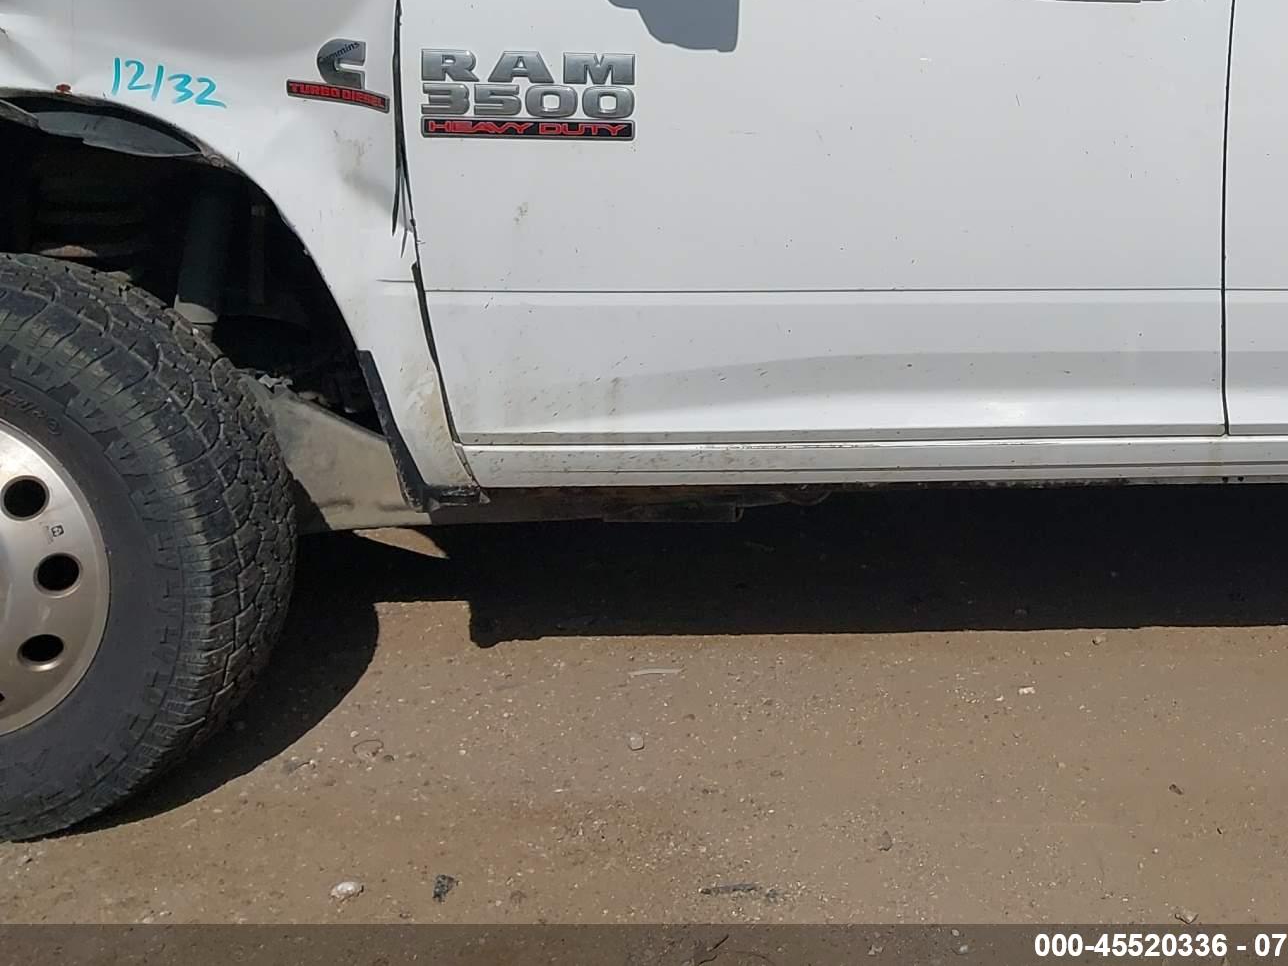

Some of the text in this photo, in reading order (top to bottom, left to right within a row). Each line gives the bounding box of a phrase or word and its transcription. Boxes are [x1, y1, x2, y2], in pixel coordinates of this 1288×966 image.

[421, 48, 635, 85] RAM
[288, 82, 386, 109] TURBO DIESEL
[420, 82, 635, 119] 3500
[427, 120, 629, 136] HEAVY DUTY
